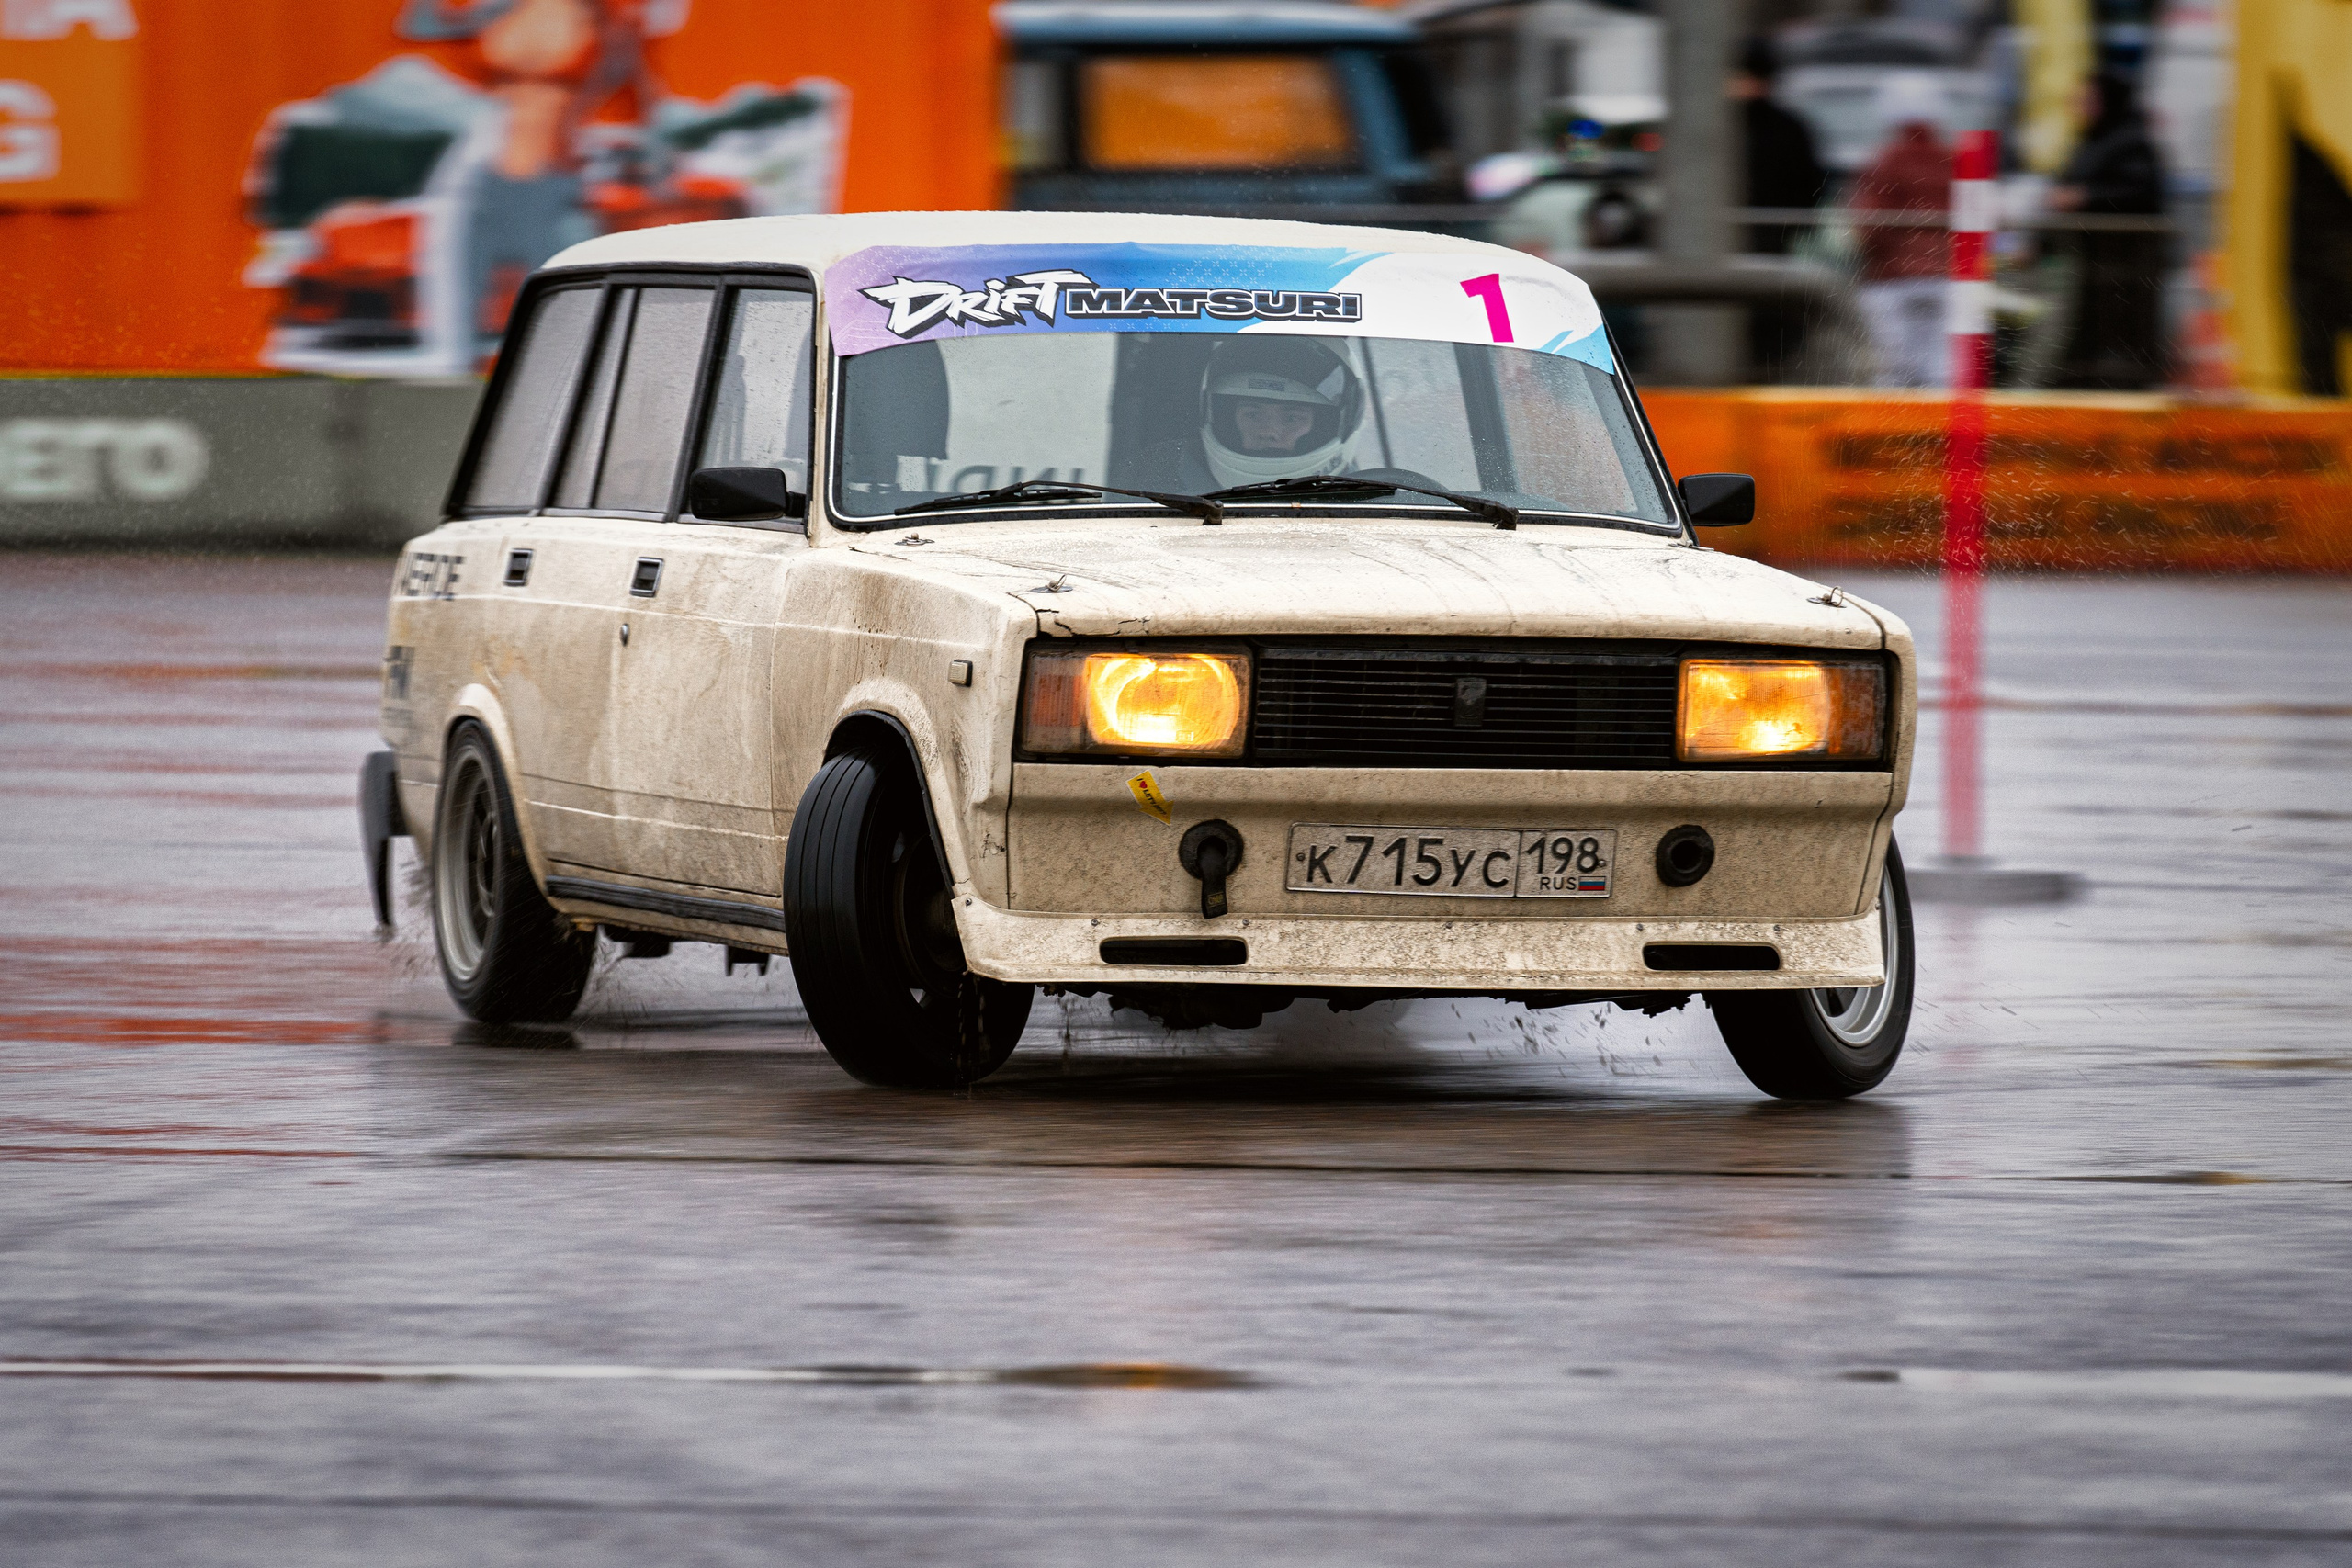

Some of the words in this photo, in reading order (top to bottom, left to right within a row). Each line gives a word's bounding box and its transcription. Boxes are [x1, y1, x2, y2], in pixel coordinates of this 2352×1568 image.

[1065, 288, 1363, 322] MATSURI
[1460, 273, 1514, 343] 1
[1526, 837, 1600, 875] 198
[1539, 876, 1577, 891] RUS
